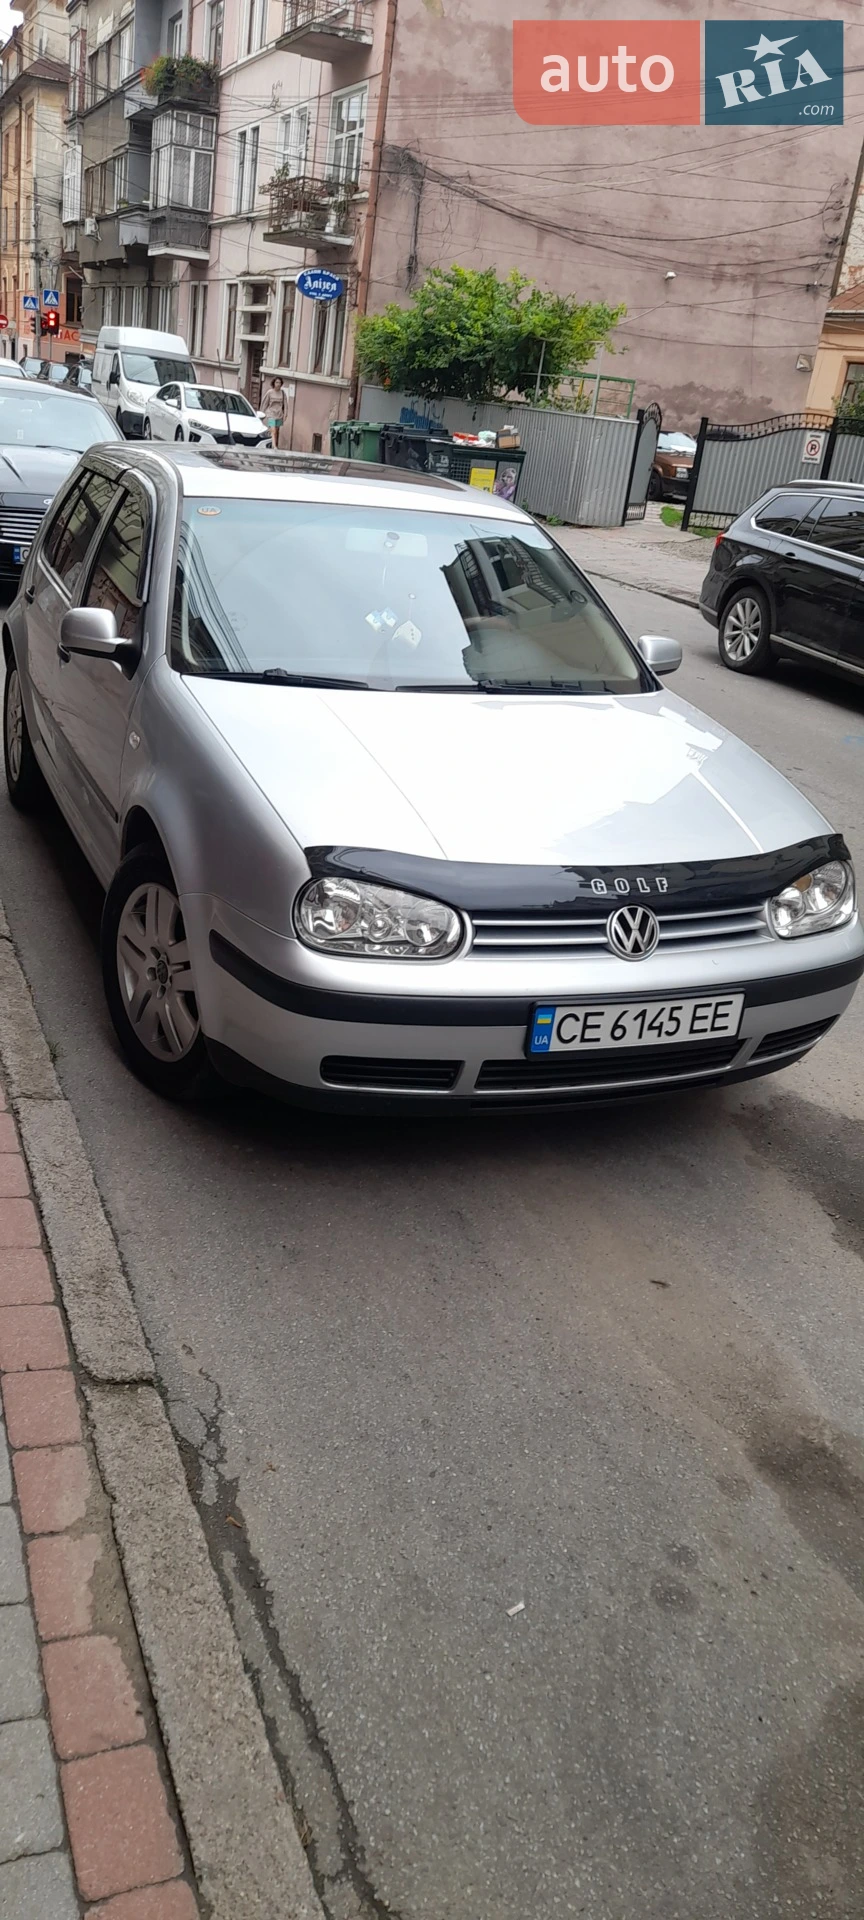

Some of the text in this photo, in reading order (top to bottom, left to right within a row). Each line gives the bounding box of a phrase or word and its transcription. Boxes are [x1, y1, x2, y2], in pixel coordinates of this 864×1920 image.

[590, 877, 669, 894] GOLF
[556, 999, 734, 1044] CE 6145 EE
[534, 1035, 549, 1046] UA
